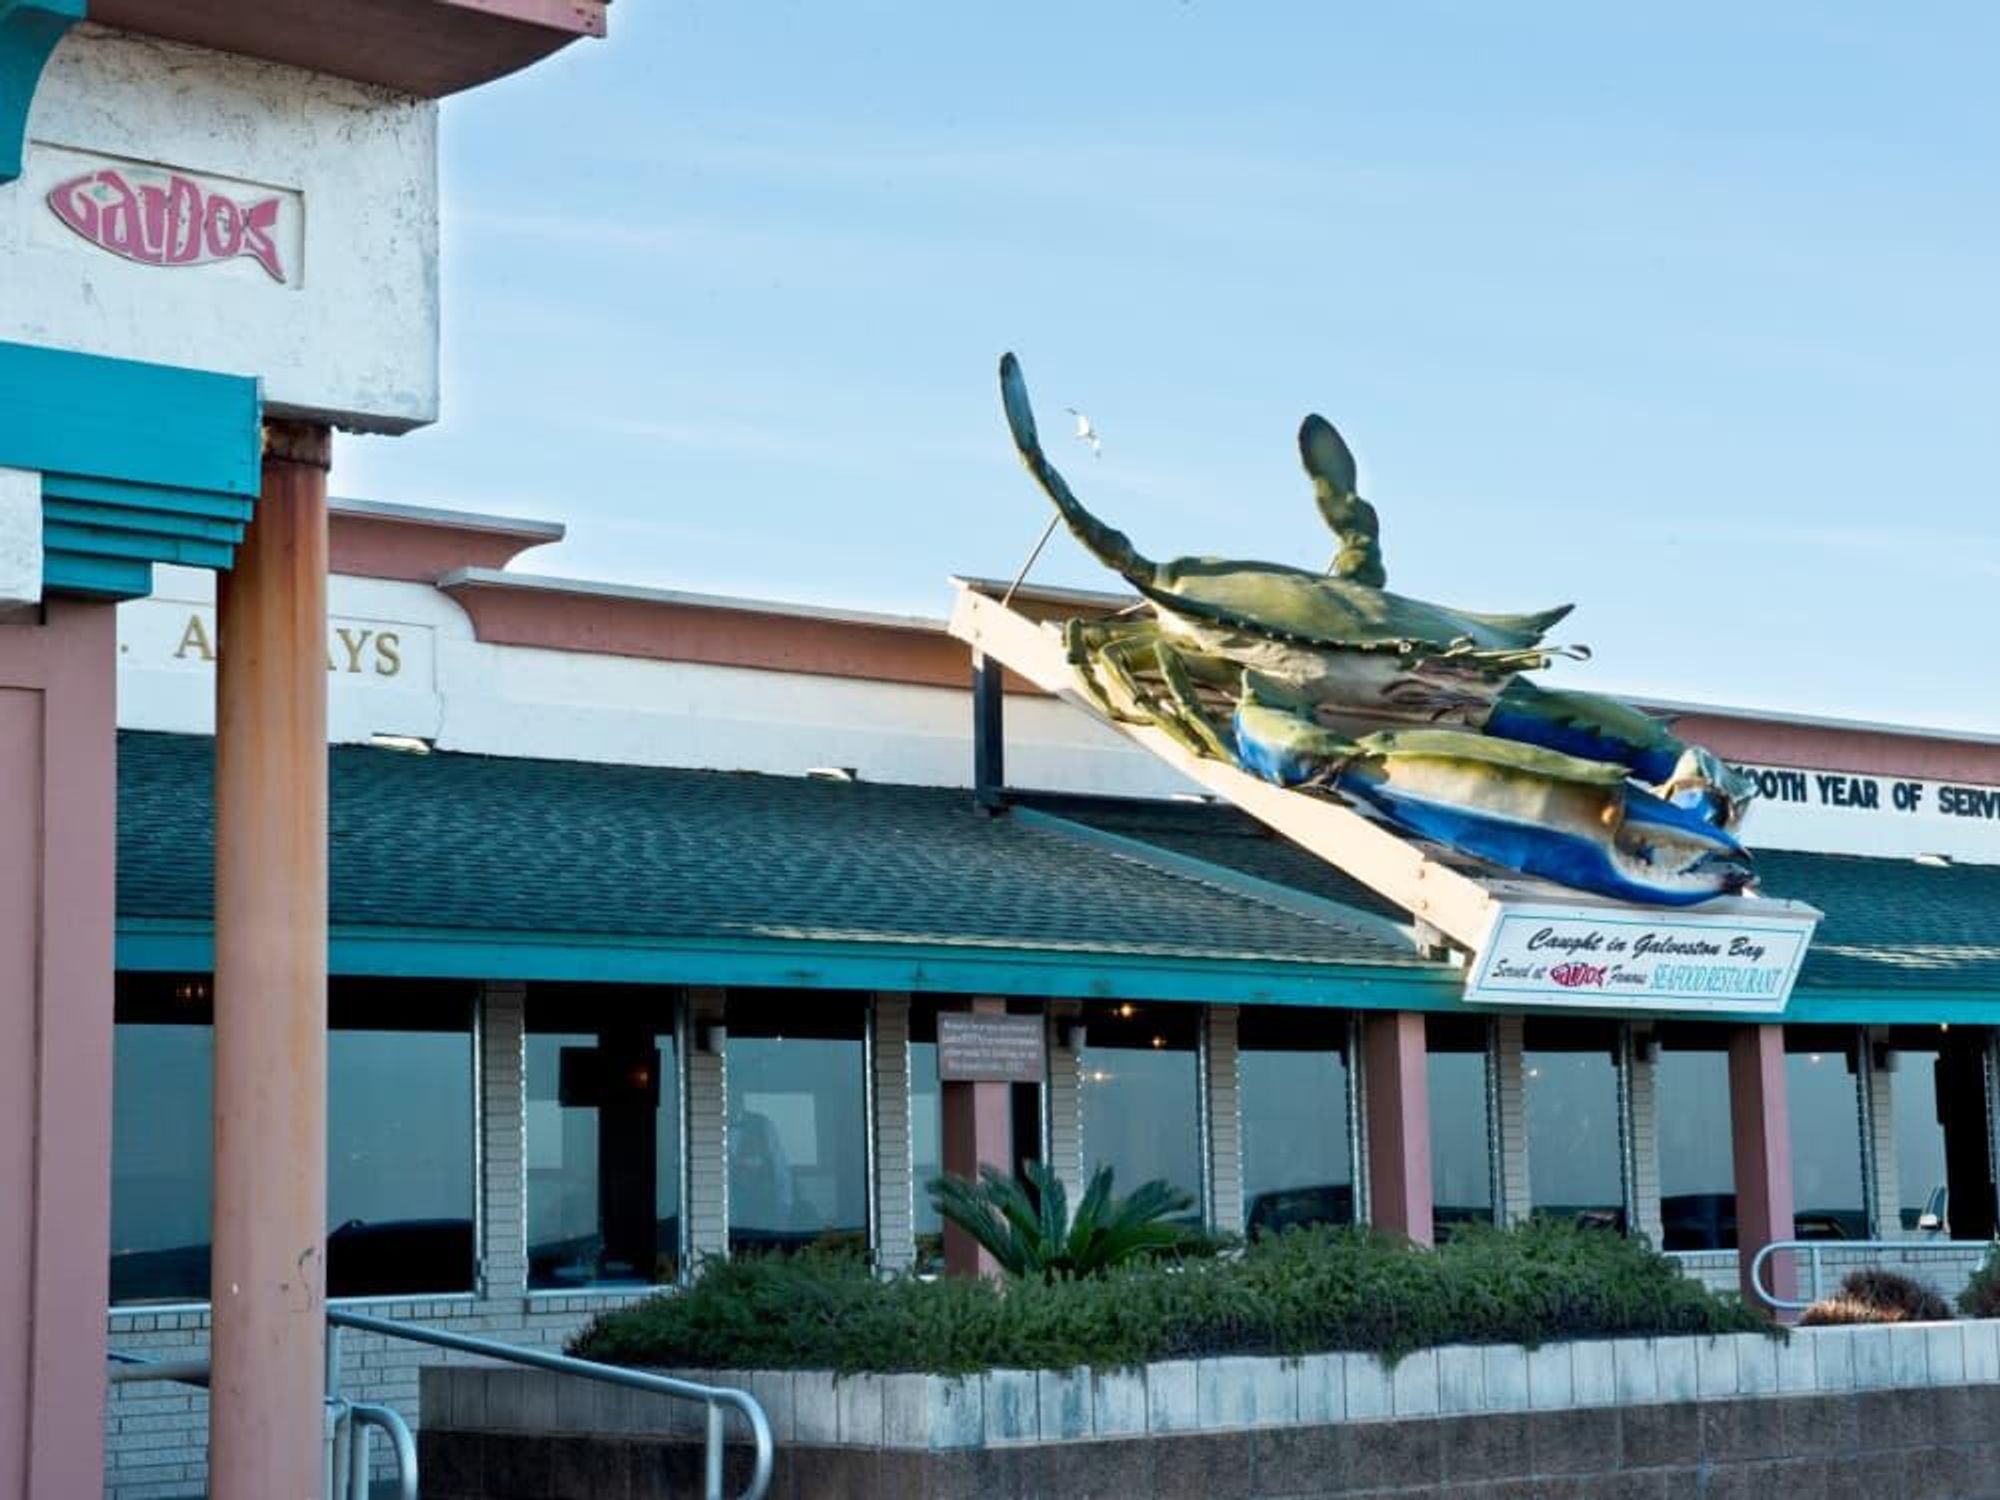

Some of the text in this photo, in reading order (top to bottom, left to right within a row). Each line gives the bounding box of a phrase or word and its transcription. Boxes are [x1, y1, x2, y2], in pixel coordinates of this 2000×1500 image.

[1816, 774, 1879, 810] YEAR
[1892, 783, 1923, 812] OF
[1527, 927, 1766, 961] Caught in Galveston Bay
[1653, 963, 1707, 992] SEAFOOD
[1705, 966, 1783, 993] RESTAURANT
